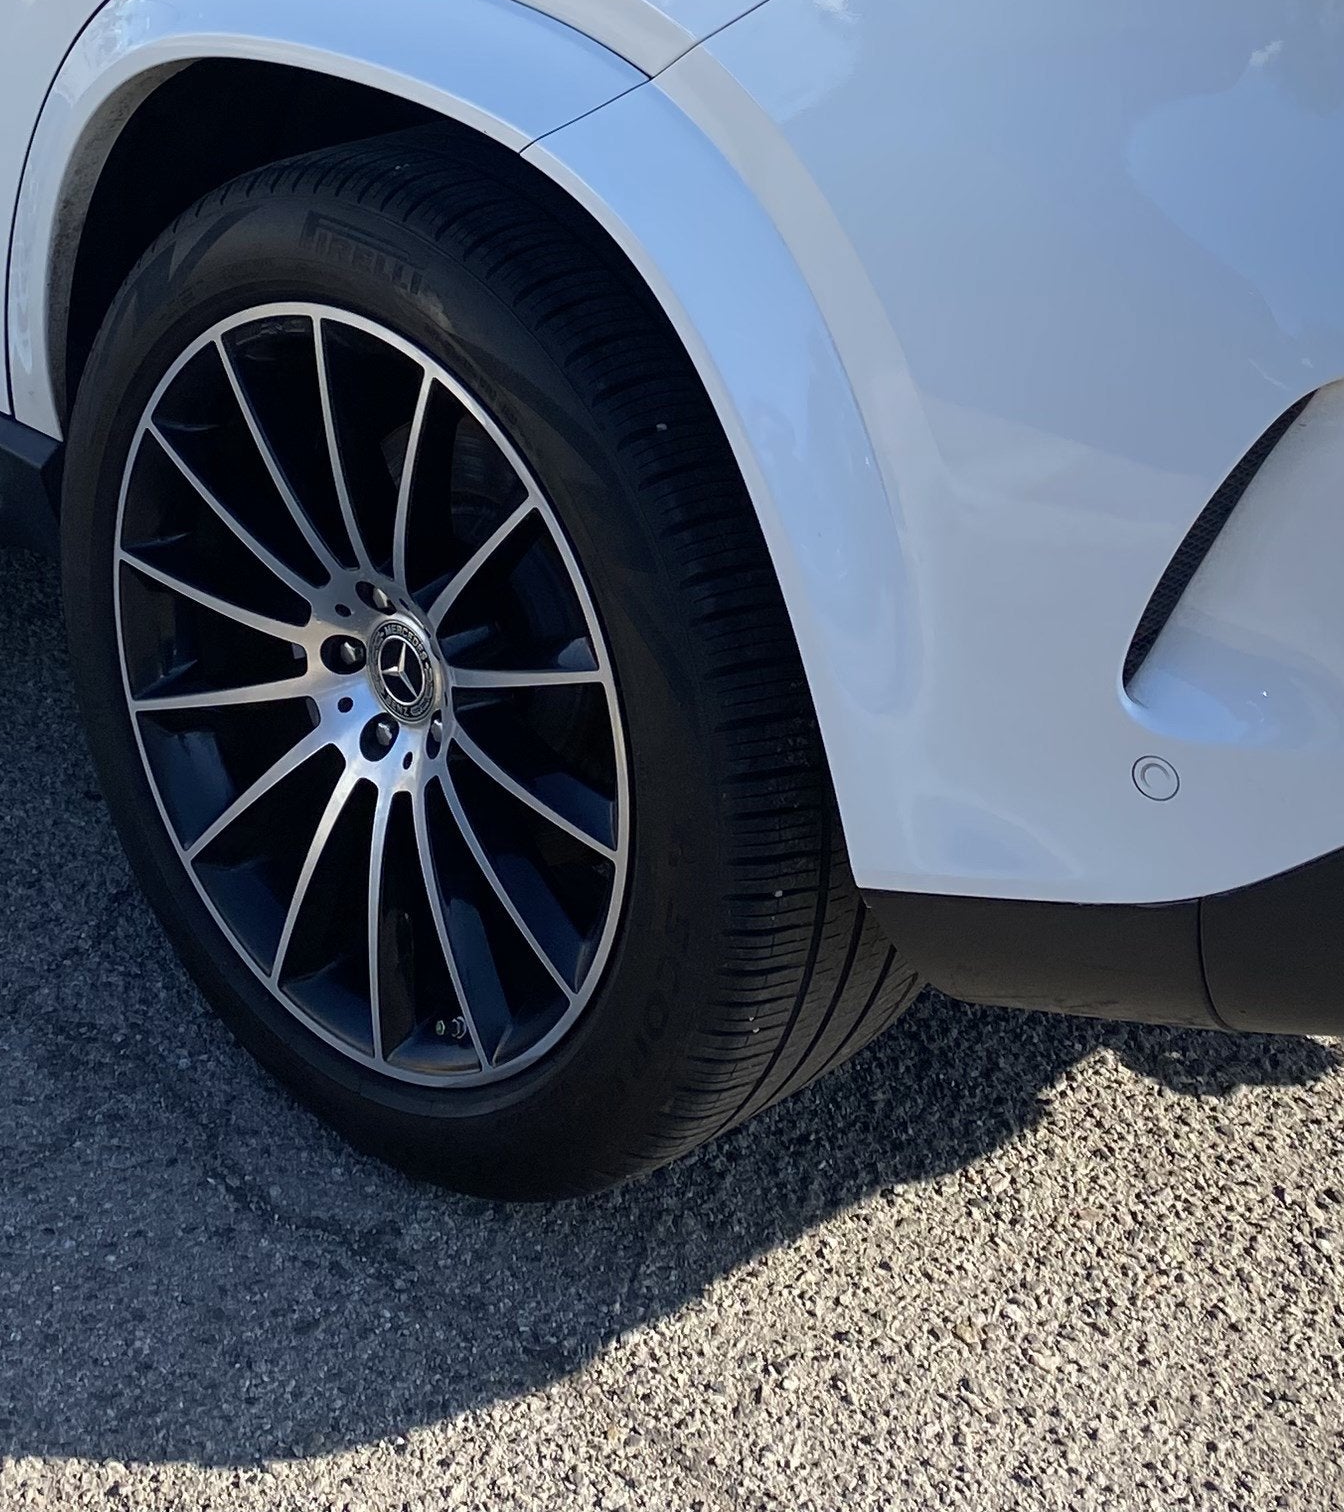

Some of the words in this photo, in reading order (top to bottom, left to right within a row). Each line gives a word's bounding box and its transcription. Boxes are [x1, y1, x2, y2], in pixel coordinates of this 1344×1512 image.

[299, 210, 424, 295] PIRELLI
[383, 623, 429, 661] MERCEDES
[385, 695, 411, 717] BENZ
